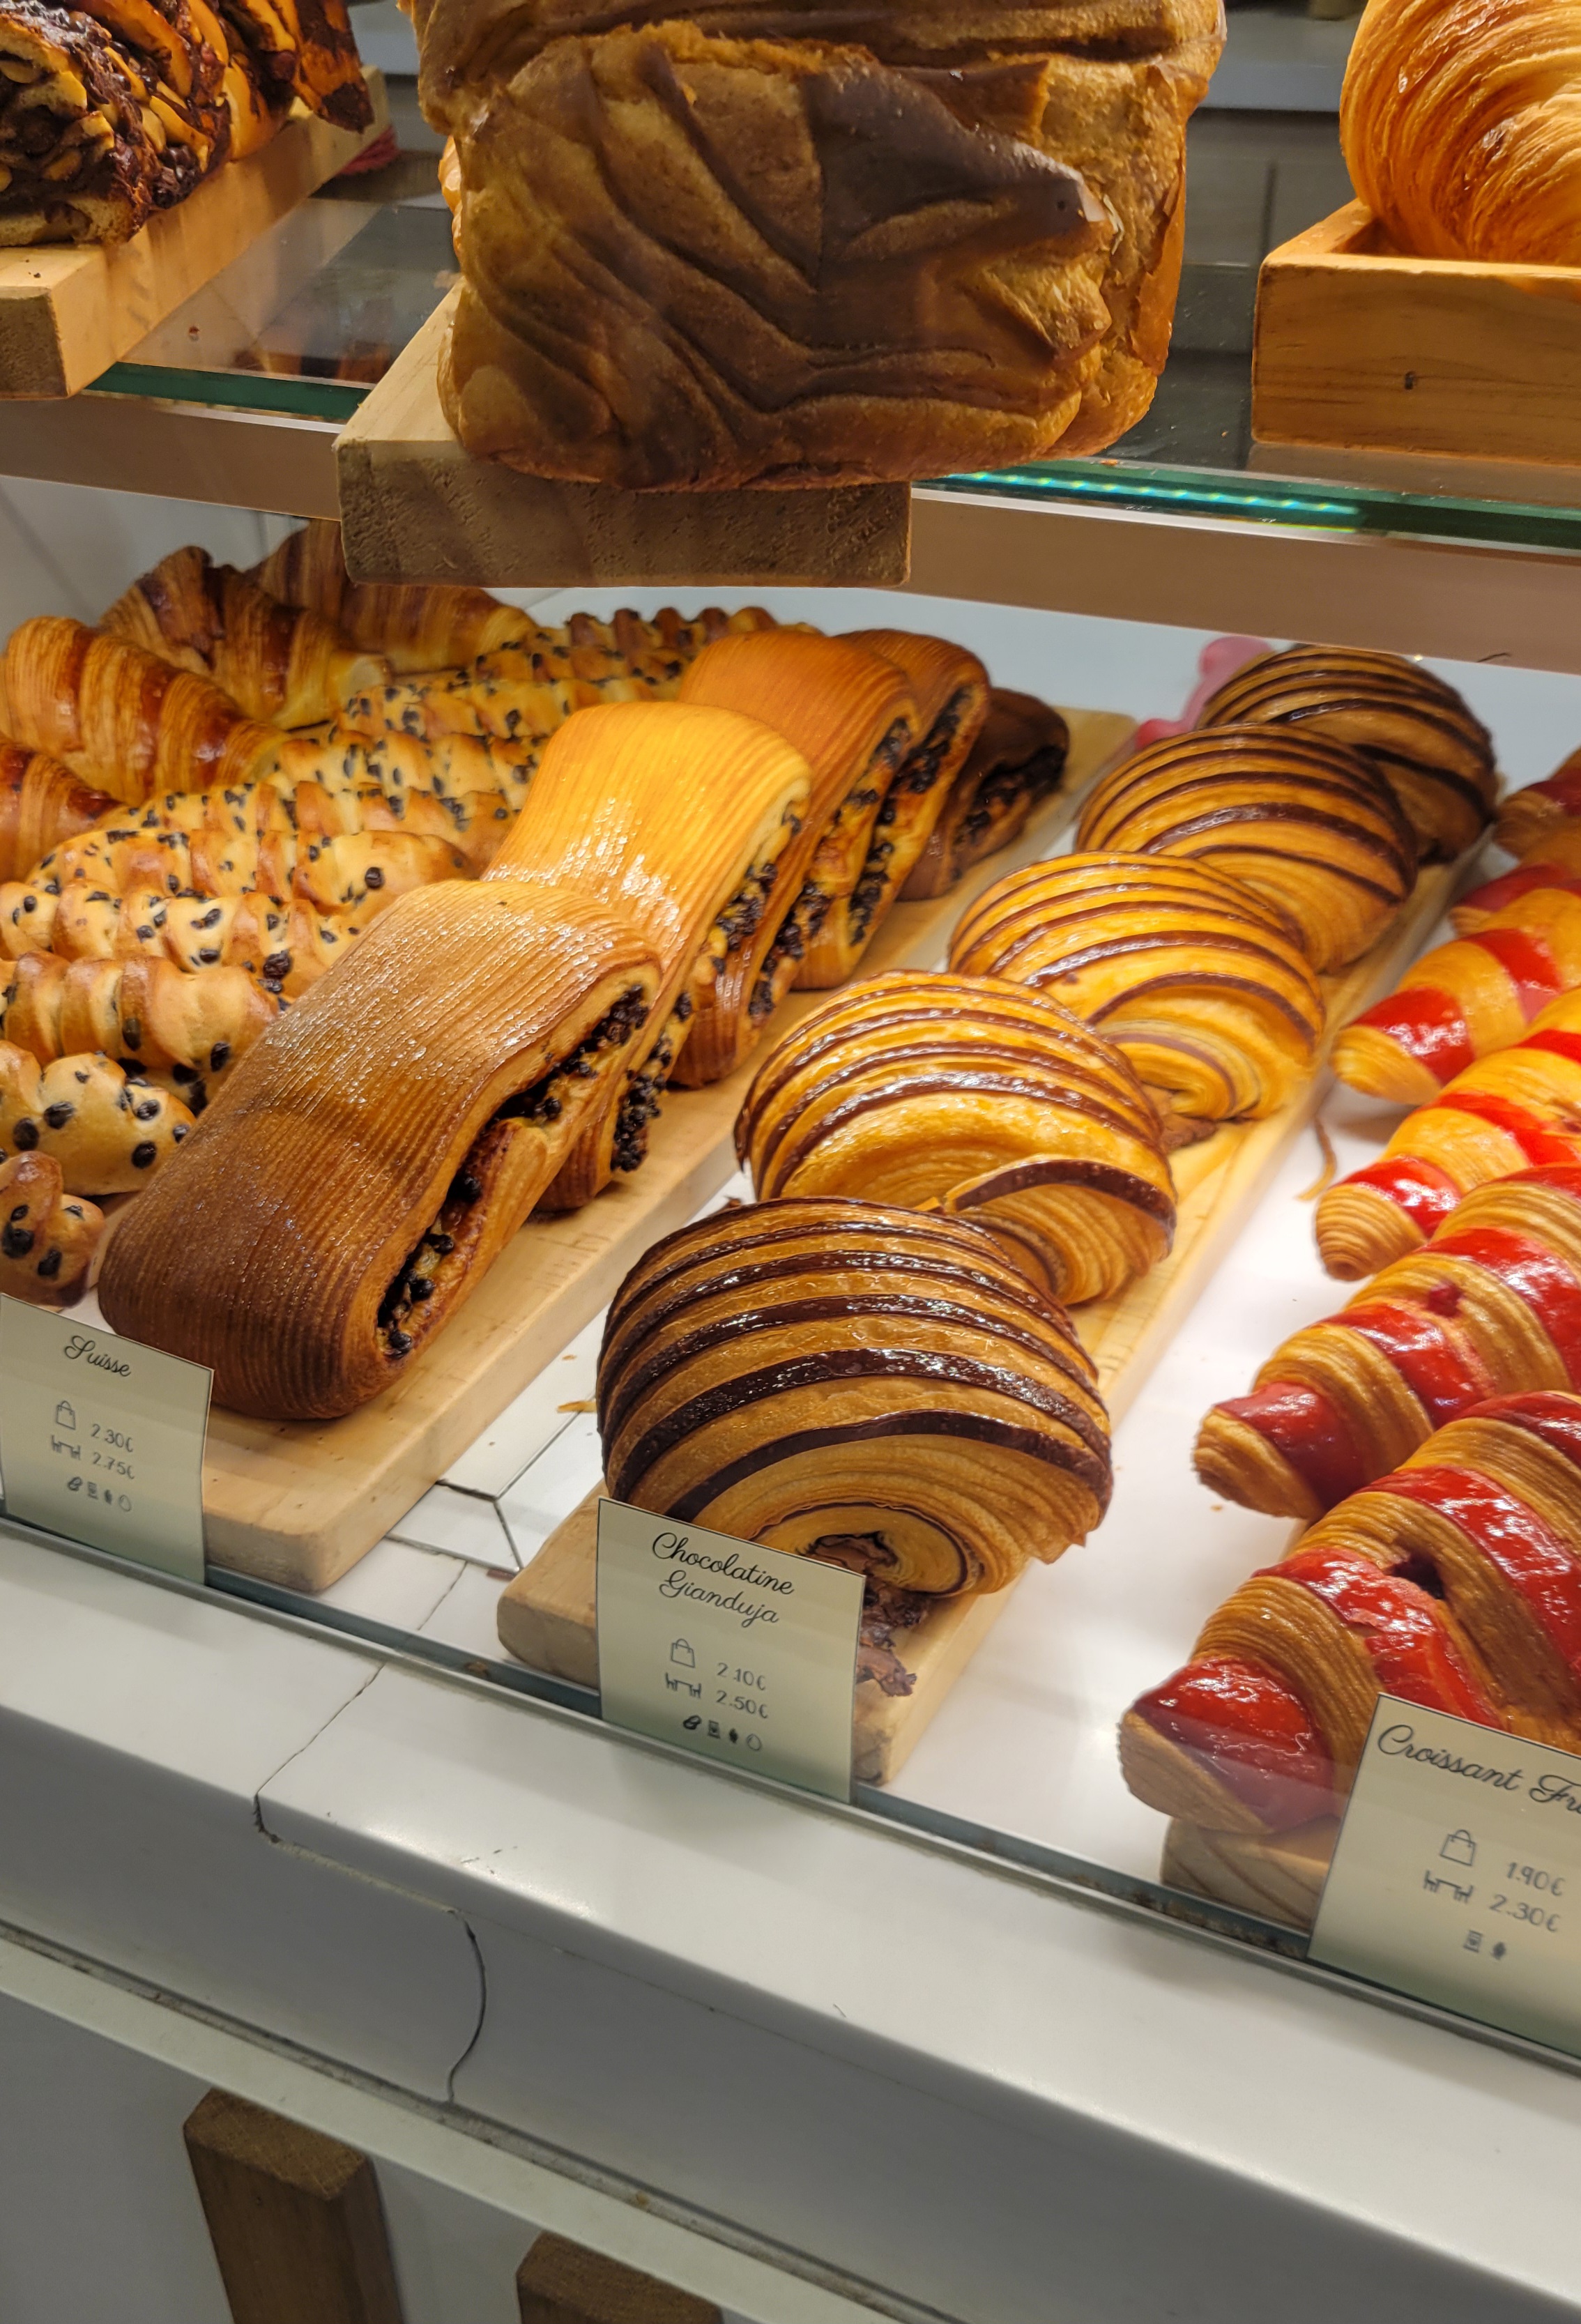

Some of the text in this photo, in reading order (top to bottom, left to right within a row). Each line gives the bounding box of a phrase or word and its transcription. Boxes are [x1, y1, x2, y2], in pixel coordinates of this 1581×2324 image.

[64, 1335, 132, 1377] Suisse
[652, 1532, 795, 1595] Chocolatine
[659, 1570, 779, 1628] Gianduja
[1377, 1725, 1524, 1791] Croissant
[1506, 1862, 1566, 1896] 1.90€
[1489, 1893, 1561, 1932] 2.30€
